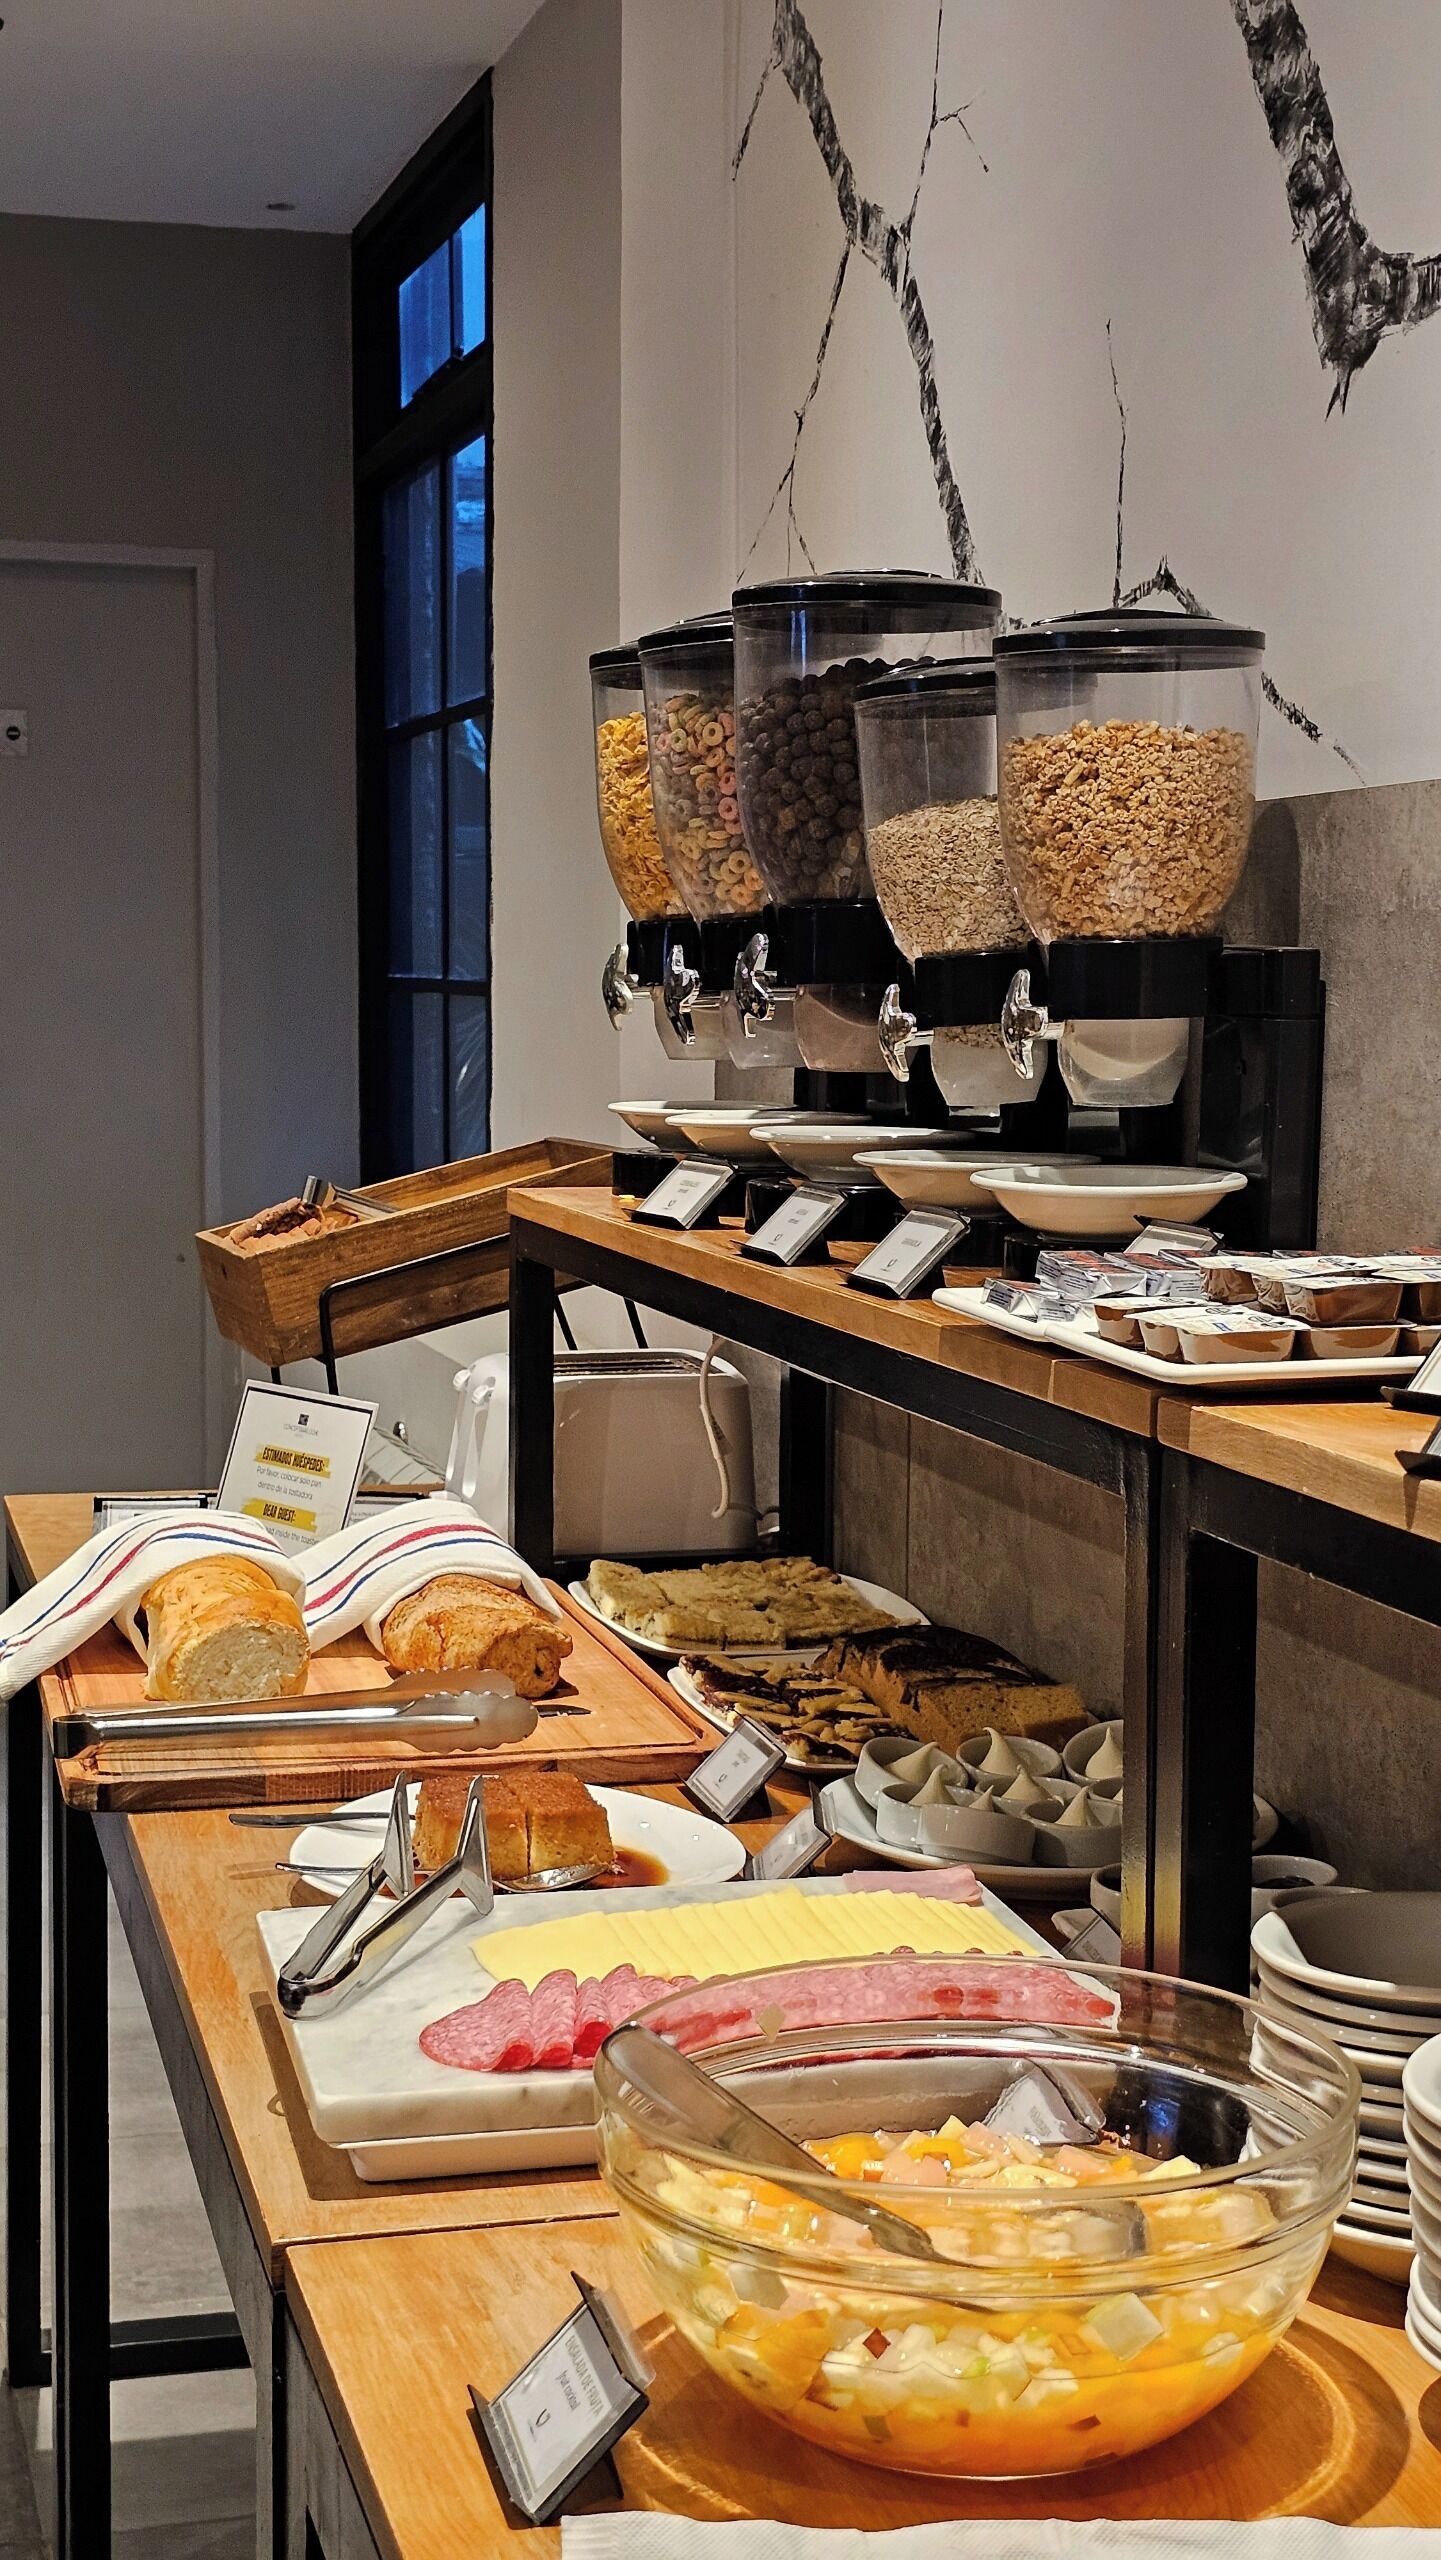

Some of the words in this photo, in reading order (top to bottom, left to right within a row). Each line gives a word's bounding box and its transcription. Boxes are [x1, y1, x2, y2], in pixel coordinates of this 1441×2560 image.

[262, 1447, 293, 1466] ESTIMADOS
[292, 1453, 325, 1473] HUÉSPEDES:
[257, 1466, 266, 1474] Por
[258, 1481, 275, 1491] dentro
[275, 1485, 282, 1493] de
[263, 1503, 278, 1518] DEAR
[277, 1507, 297, 1523] GUEST:
[291, 1532, 300, 1540] the
[565, 2334, 588, 2378] ENSALADA
[581, 2374, 594, 2391] DE
